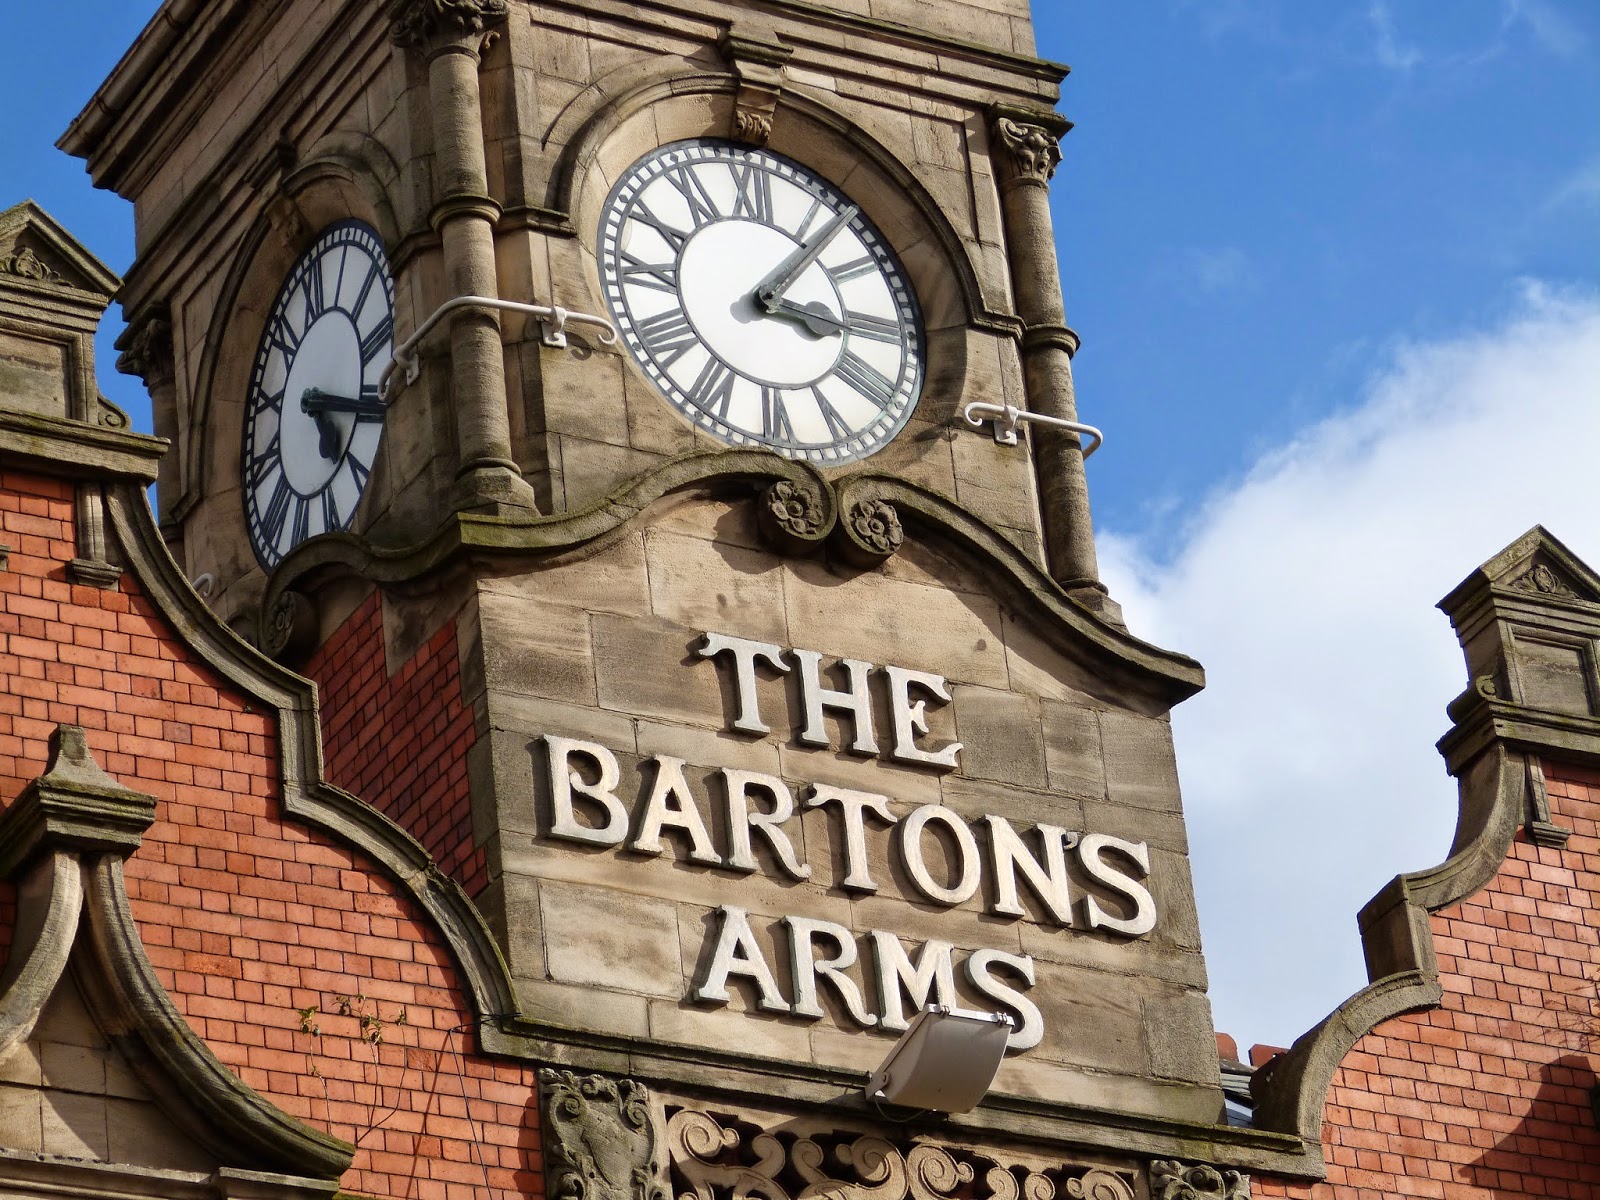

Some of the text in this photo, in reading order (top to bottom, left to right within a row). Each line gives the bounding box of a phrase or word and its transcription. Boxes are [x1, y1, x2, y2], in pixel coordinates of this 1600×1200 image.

[628, 198, 690, 253] X
[663, 165, 721, 228] XI
[728, 163, 773, 226] XII
[793, 198, 822, 238] I
[301, 255, 324, 332] XII
[620, 251, 678, 295] IX
[828, 254, 880, 285] II
[637, 307, 700, 369] VIII
[845, 310, 902, 346] III
[687, 355, 736, 420] VII
[832, 349, 896, 411] IIII
[760, 385, 799, 443] VI
[812, 385, 855, 442] V
[698, 632, 964, 771] THE
[697, 905, 1044, 1050] ARMS
